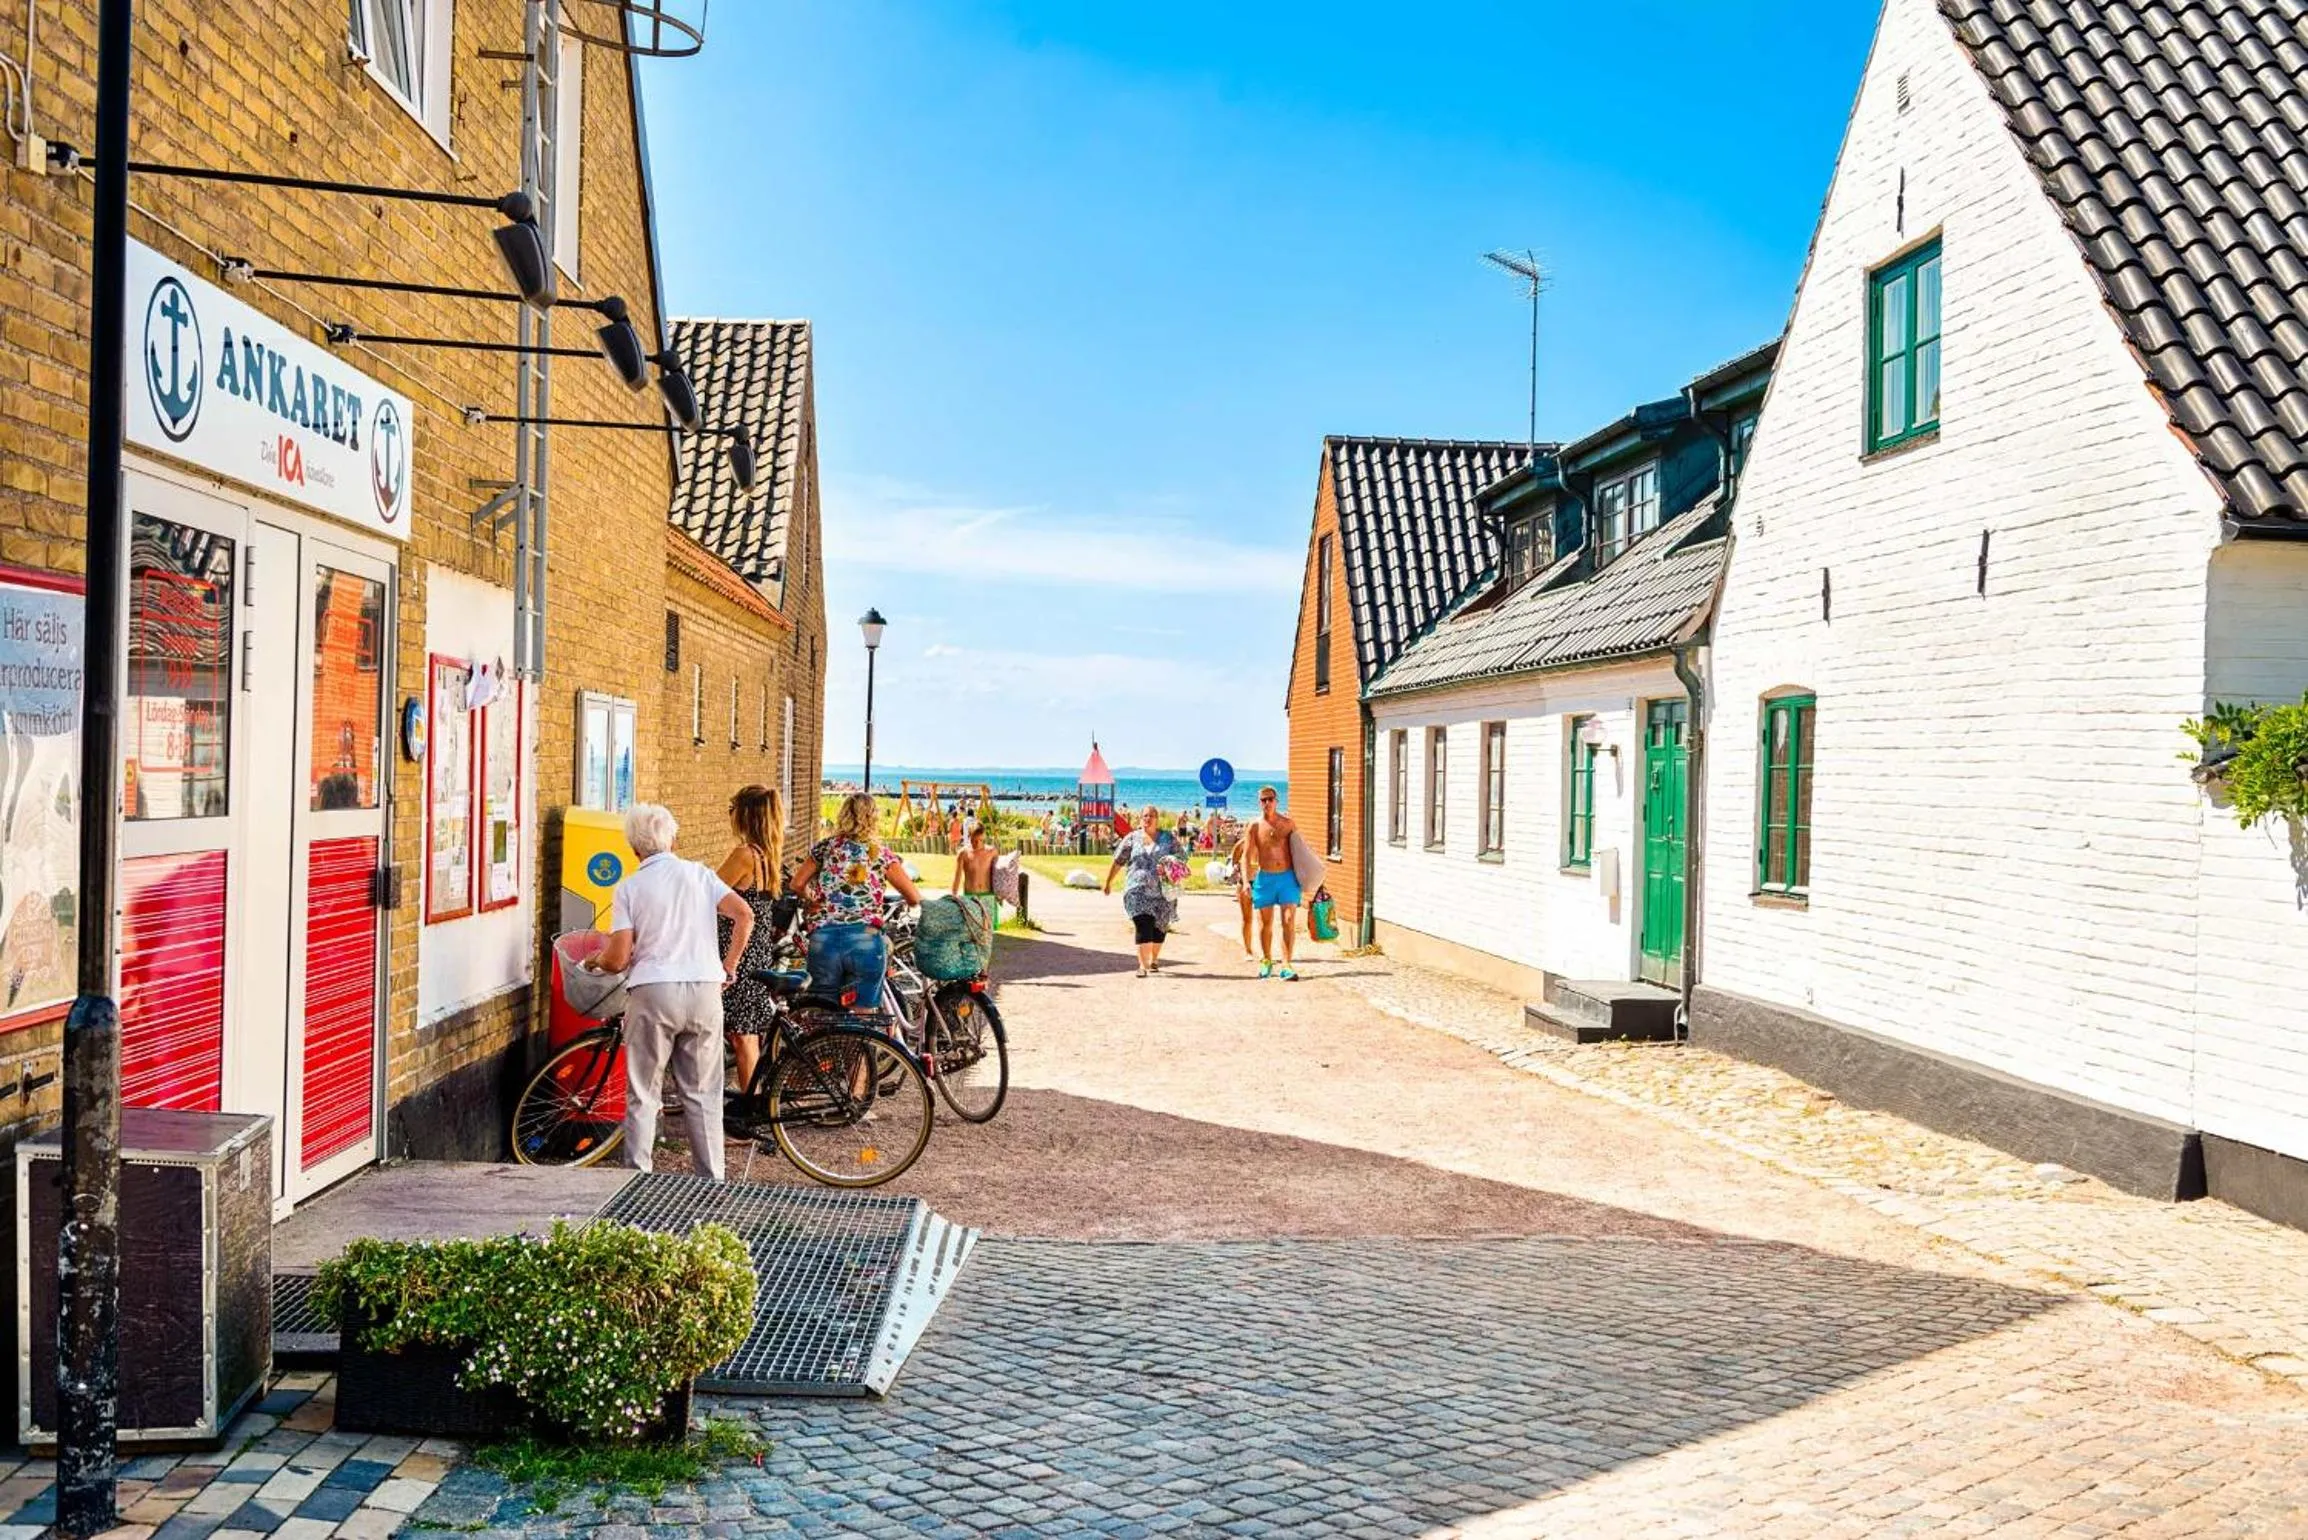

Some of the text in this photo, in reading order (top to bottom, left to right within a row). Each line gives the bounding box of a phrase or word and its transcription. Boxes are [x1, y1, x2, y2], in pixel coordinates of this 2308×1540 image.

[217, 326, 362, 451] ANKARET
[278, 433, 304, 487] ICA
[3, 607, 68, 654] Här säljs
[0, 657, 82, 696] rproducera
